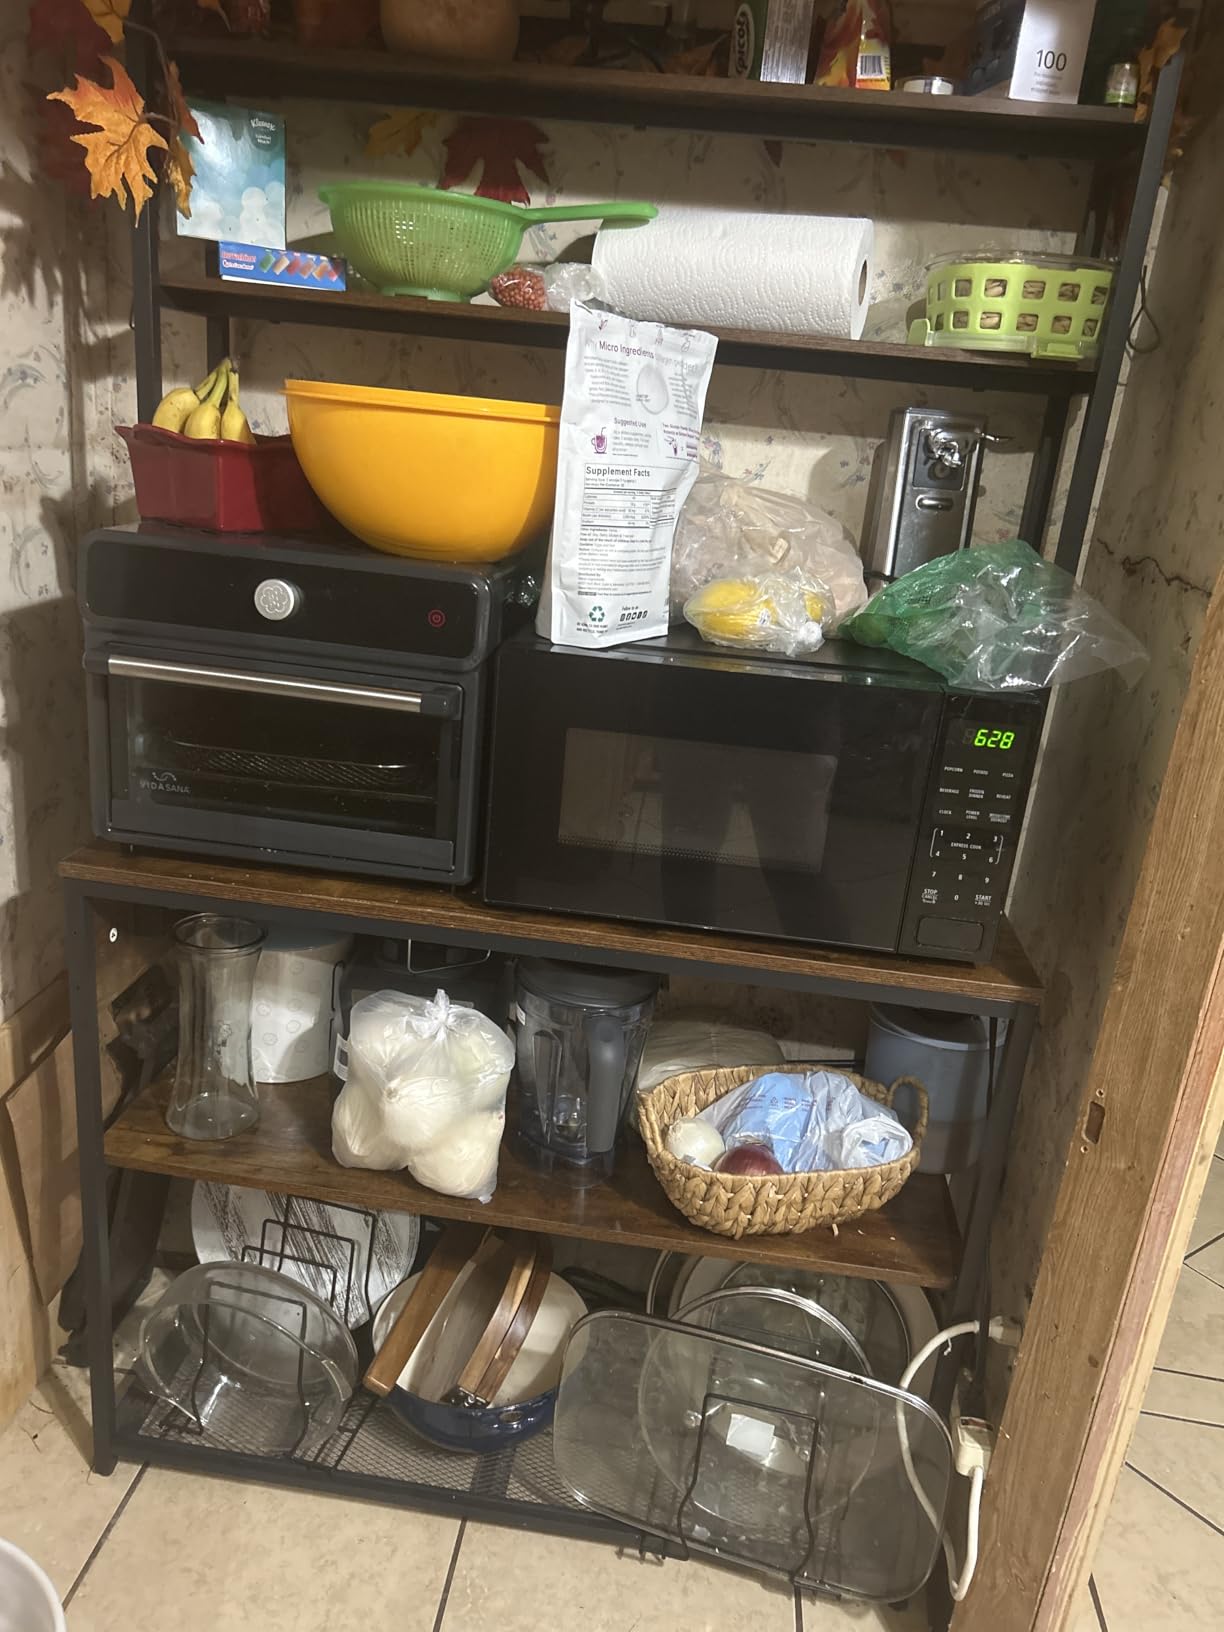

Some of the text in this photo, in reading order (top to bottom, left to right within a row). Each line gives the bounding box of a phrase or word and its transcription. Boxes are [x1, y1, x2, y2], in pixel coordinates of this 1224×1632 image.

[1036, 49, 1068, 72] 100
[599, 340, 619, 353] Micro
[620, 345, 655, 359] Ingredients
[586, 466, 651, 477] Supplement Facts
[940, 829, 998, 843] 1 2 3
[958, 873, 963, 881] 8
